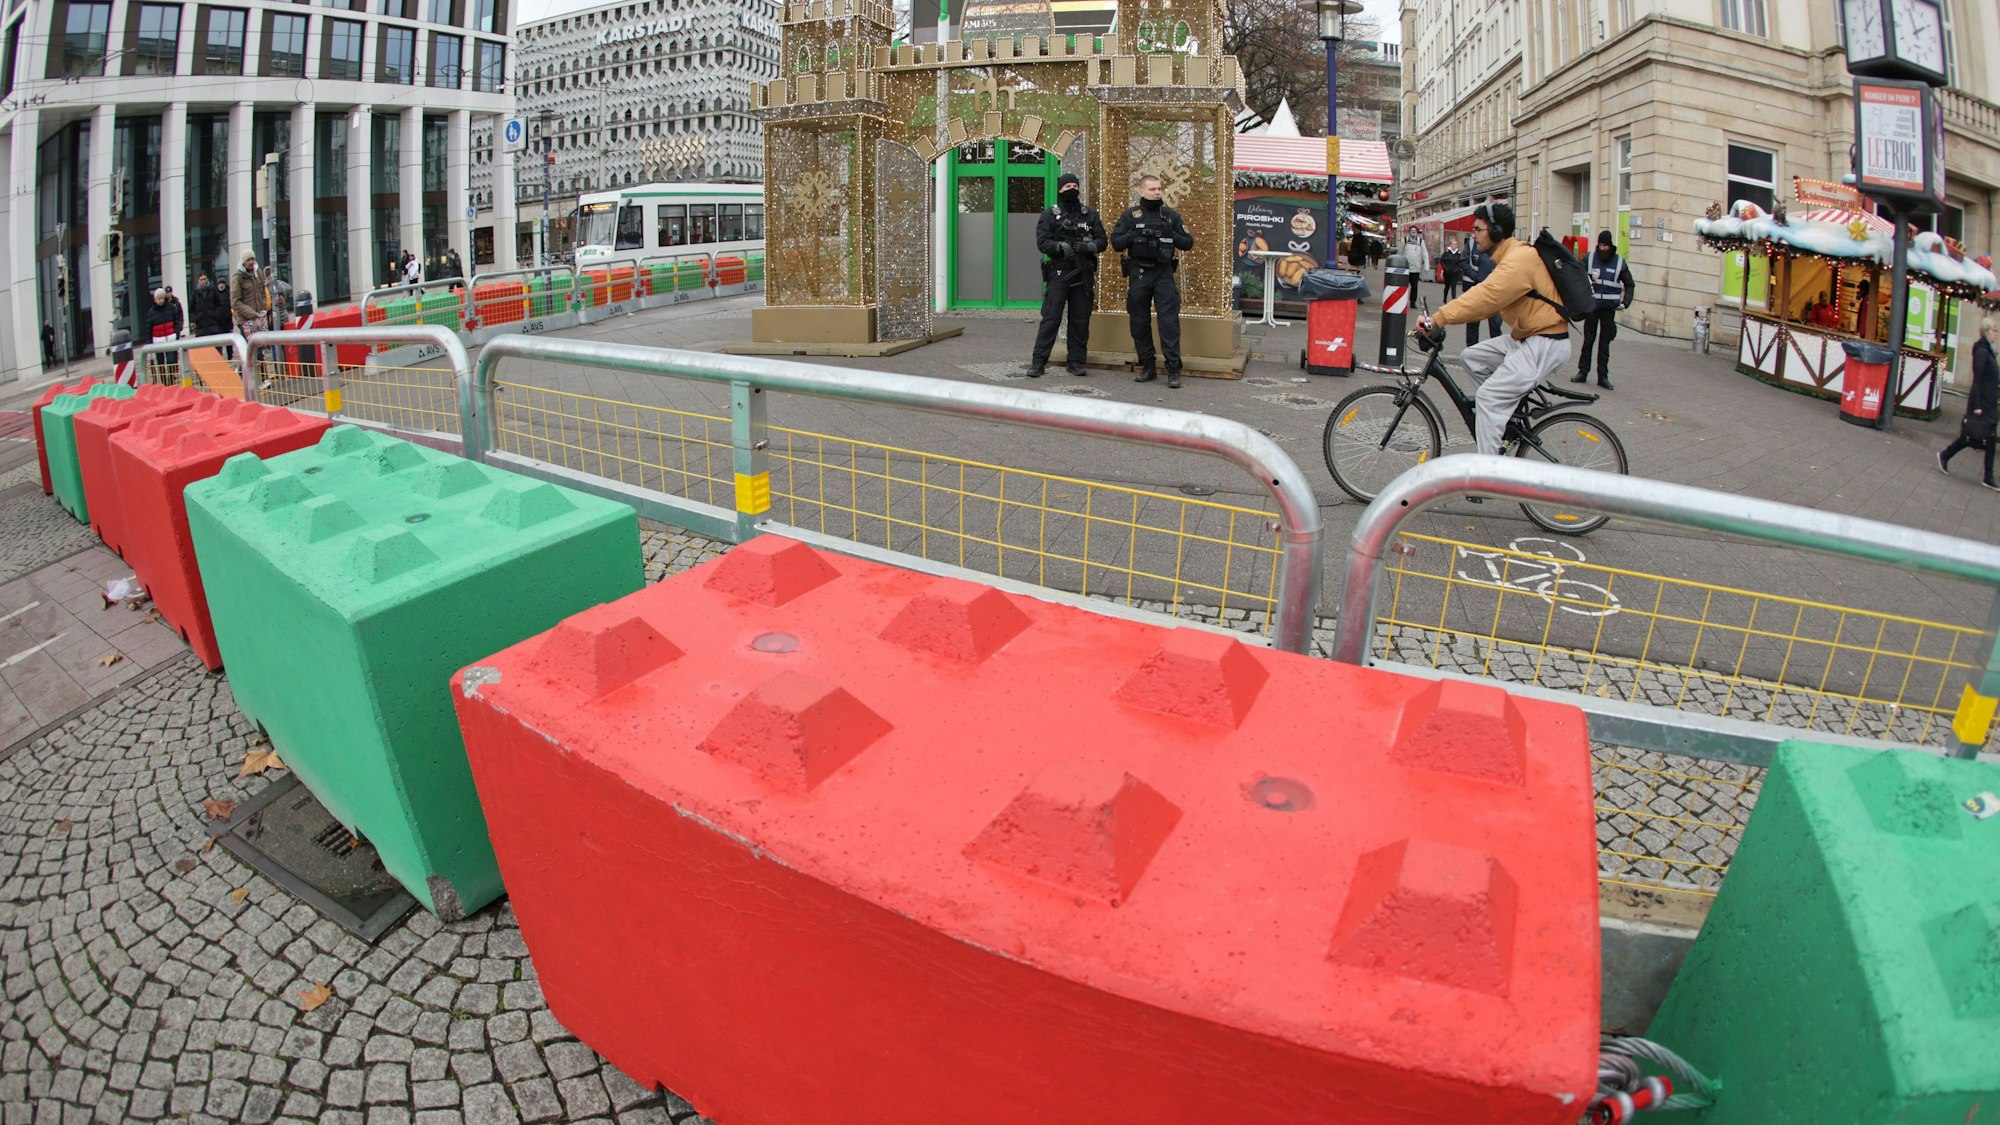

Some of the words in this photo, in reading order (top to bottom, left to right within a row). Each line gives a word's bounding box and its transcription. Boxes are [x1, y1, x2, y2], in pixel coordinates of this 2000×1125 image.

[595, 13, 695, 46] KARSTADT
[742, 10, 781, 40] KARSTA
[1802, 190, 1855, 209] Schlemmergrill
[1236, 213, 1284, 223] PIROSHKI
[530, 323, 544, 332] AVS
[426, 344, 440, 356] AVS
